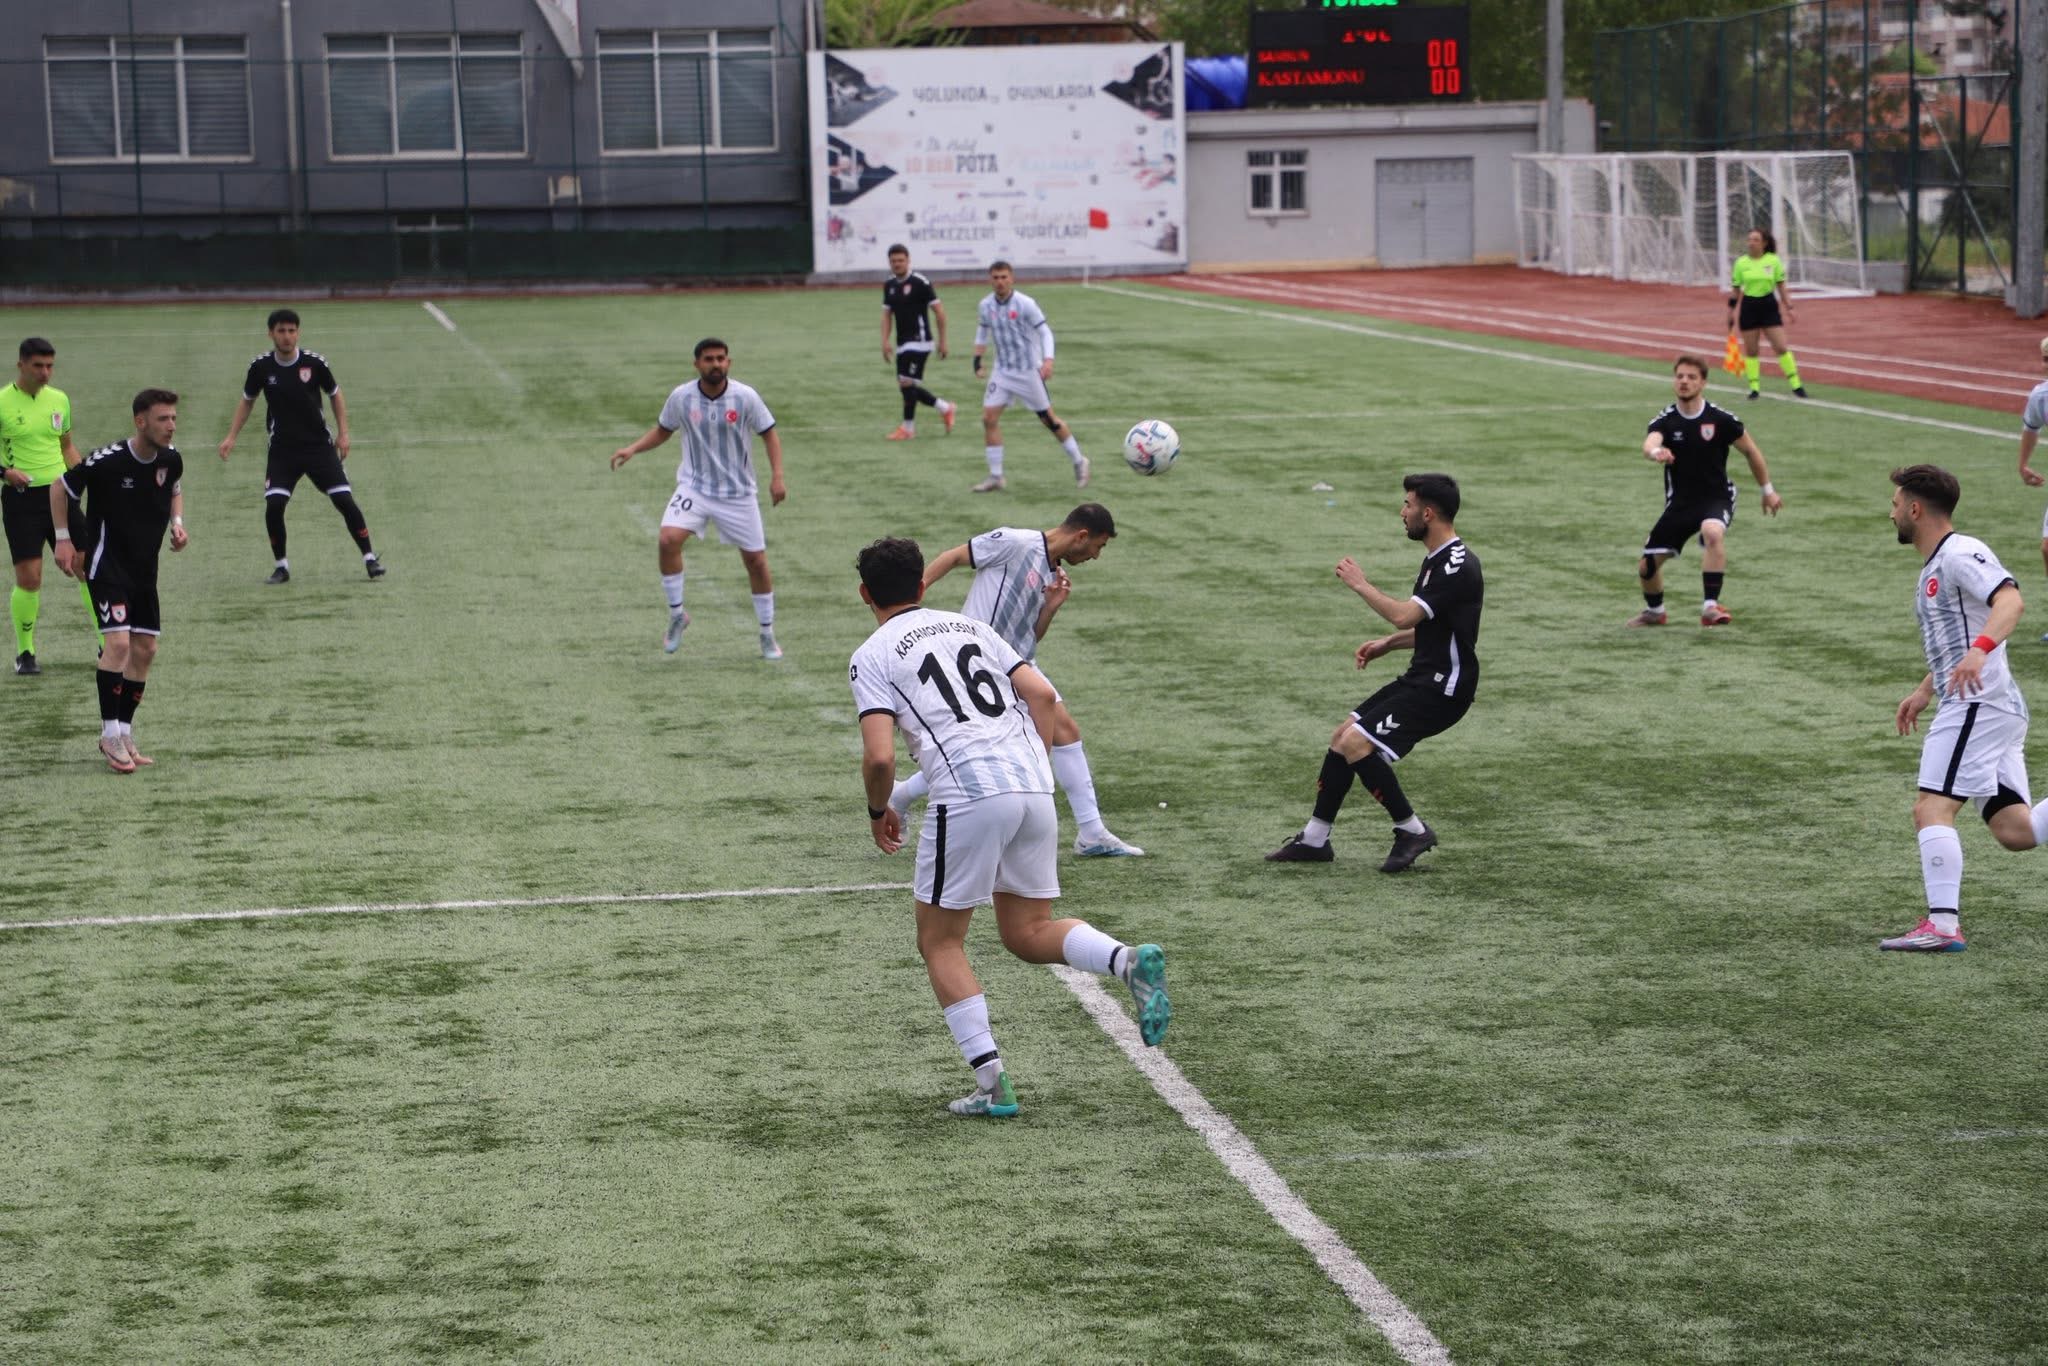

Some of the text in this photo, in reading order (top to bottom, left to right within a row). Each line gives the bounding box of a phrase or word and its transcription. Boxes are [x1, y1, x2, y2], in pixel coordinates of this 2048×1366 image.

[1427, 39, 1458, 67] 00
[1430, 67, 1461, 95] 00
[956, 153, 998, 173] POTA
[670, 494, 693, 511] 20
[894, 621, 950, 660] KASTAMONU
[917, 642, 1007, 724] 16
